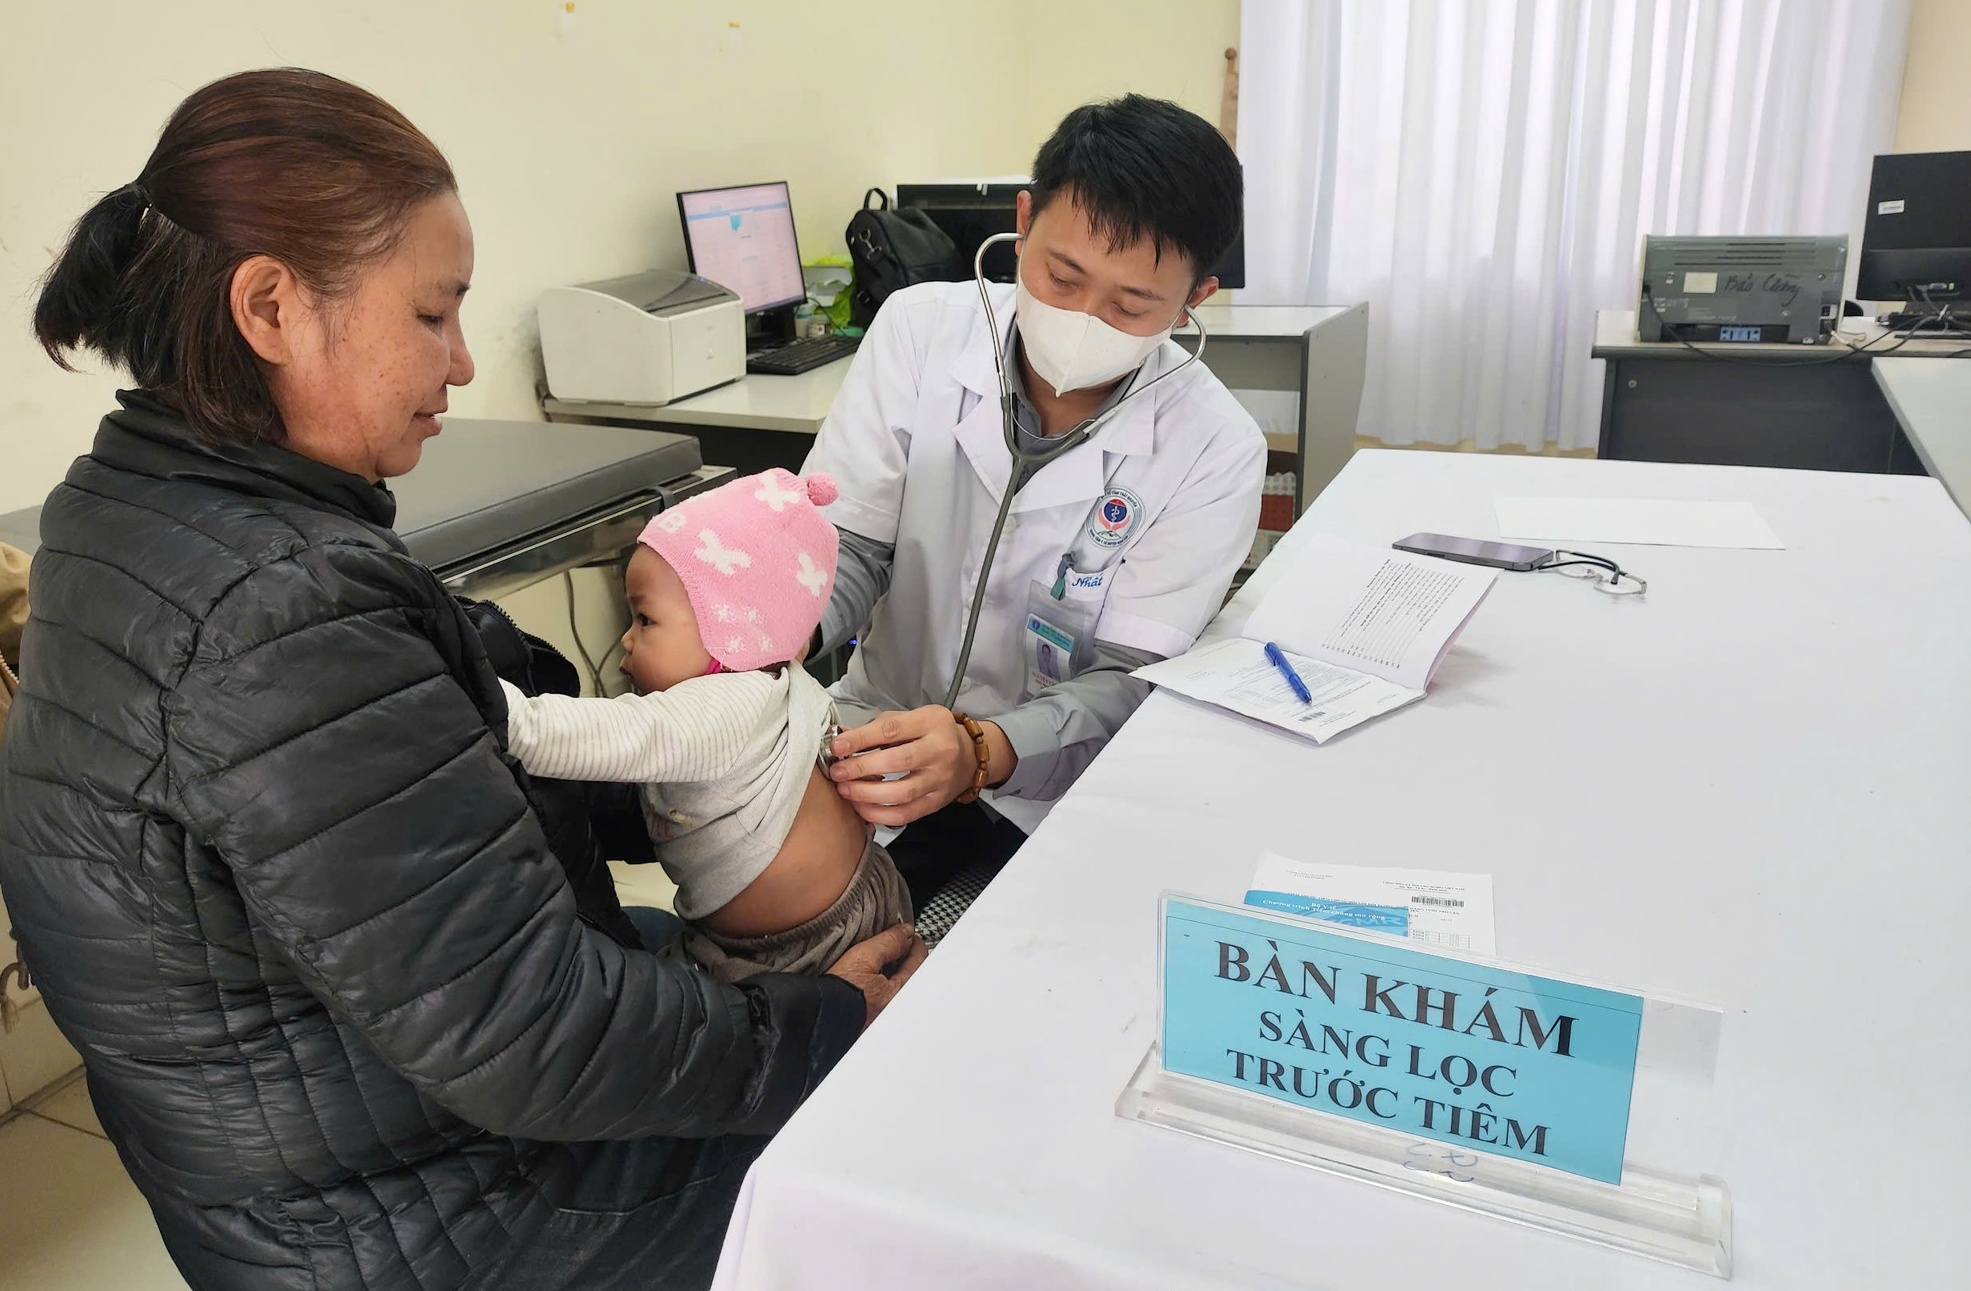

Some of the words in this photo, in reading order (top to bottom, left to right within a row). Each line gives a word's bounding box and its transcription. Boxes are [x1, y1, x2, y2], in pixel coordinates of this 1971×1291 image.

[1214, 940, 1342, 1005] BÀN
[1360, 973, 1580, 1058] KHÁM
[1258, 1010, 1392, 1068] SÀNG
[1407, 1044, 1518, 1097] LỌC
[1226, 1048, 1399, 1119] TRƯỚC
[1413, 1096, 1552, 1157] TIÊM
